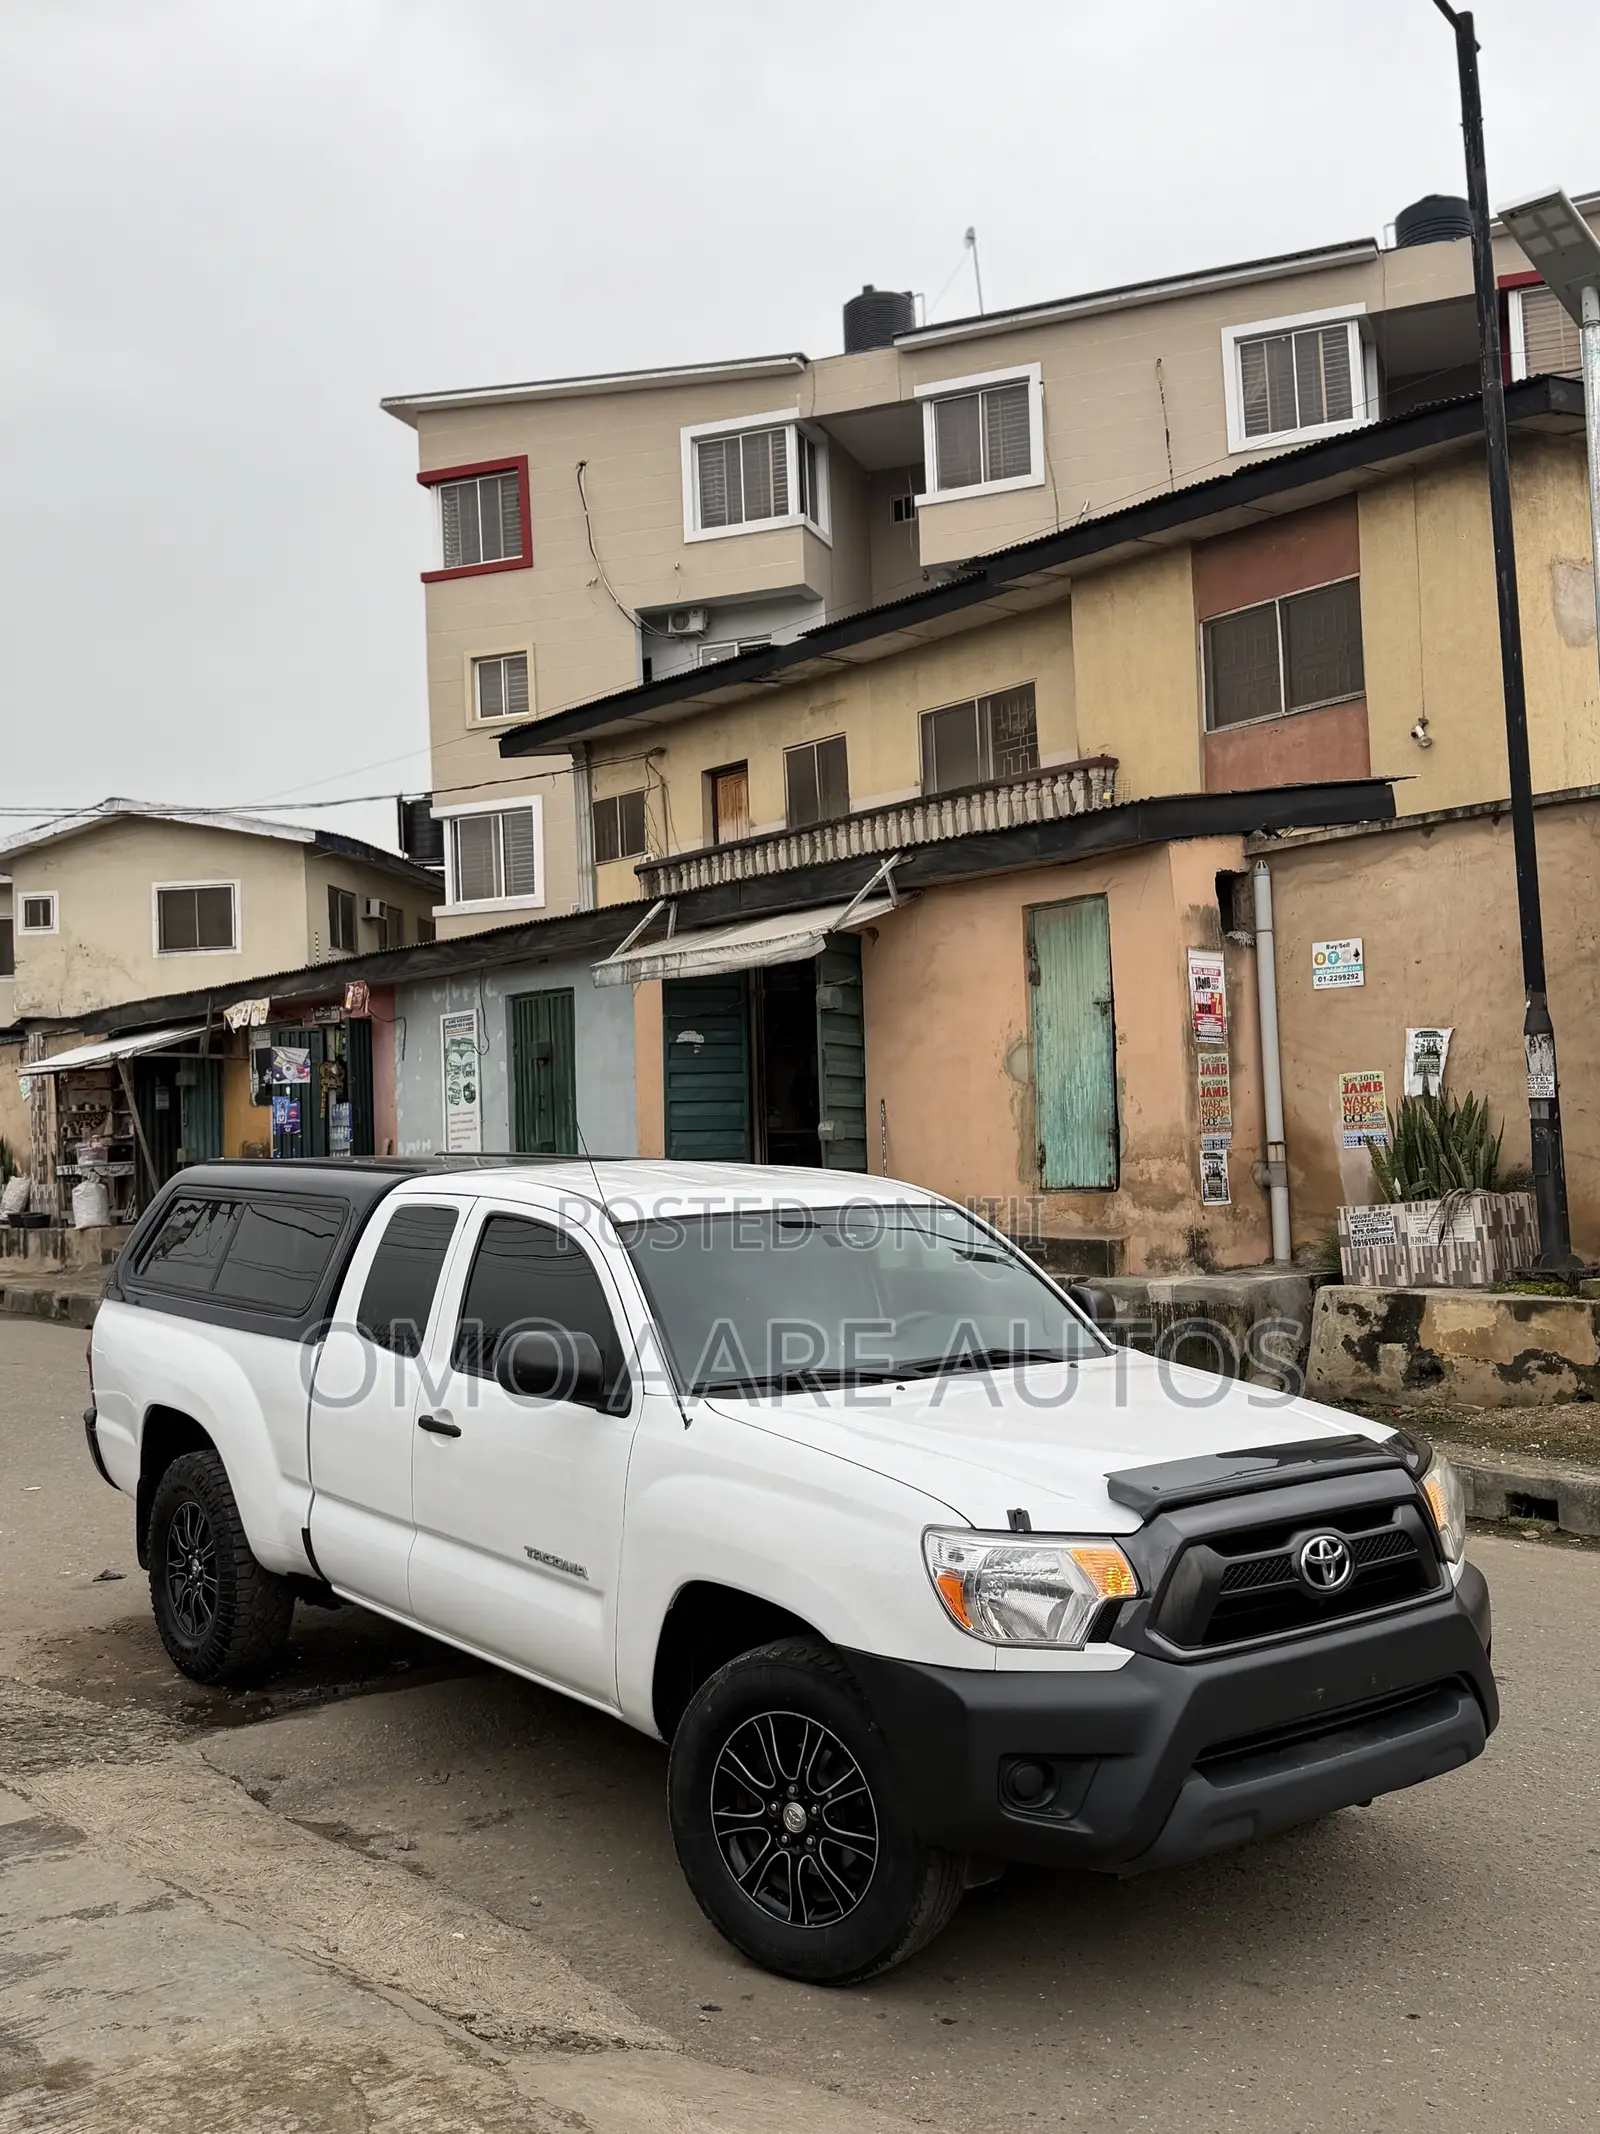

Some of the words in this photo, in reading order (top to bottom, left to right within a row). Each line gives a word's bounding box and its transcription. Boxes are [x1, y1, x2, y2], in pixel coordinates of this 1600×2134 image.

[1200, 1063, 1228, 1076] JAMB
[1358, 1073, 1381, 1082] 300+
[1200, 1086, 1228, 1098] JAMB
[1342, 1081, 1383, 1095] JAMB
[1201, 1099, 1221, 1109] WAEC
[1342, 1095, 1374, 1106] WAEC
[1202, 1108, 1223, 1118] NECO
[1343, 1104, 1376, 1114] NECO
[1202, 1117, 1218, 1127] GCE
[1343, 1113, 1367, 1123] GCE
[1374, 1210, 1391, 1218] HELP
[523, 1545, 589, 1581] TACOMA
